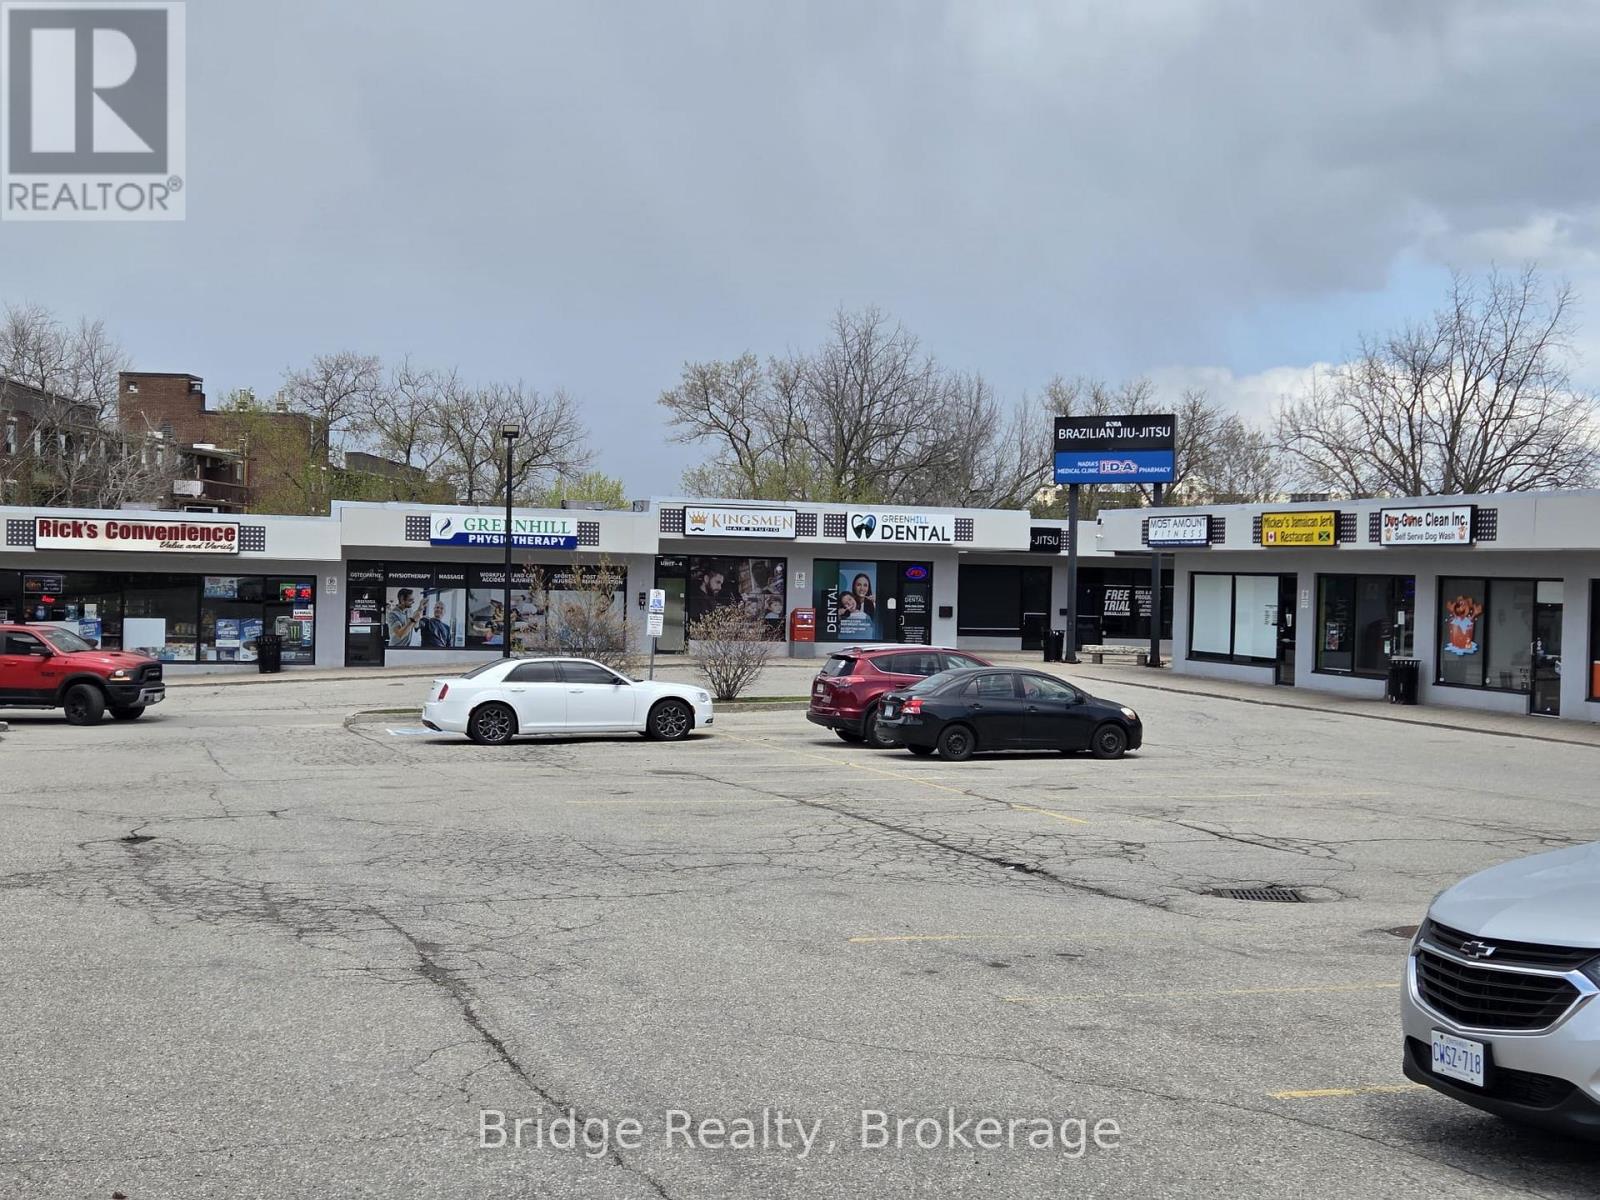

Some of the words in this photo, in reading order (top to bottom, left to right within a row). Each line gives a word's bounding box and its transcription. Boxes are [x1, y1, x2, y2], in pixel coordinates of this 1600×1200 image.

[1058, 427, 1115, 439] BRAZILIAN
[1117, 426, 1171, 438] JIU-JITSU
[712, 513, 793, 529] KINGSMEN
[881, 514, 929, 524] GREENHILL
[1150, 518, 1171, 528] MOST
[1173, 517, 1206, 528] AMOUNT
[1425, 512, 1450, 527] Clean
[1452, 511, 1468, 526] Inc.
[38, 519, 98, 539] Rick's
[105, 521, 236, 542] Convenience
[464, 517, 571, 534] GRENHILL
[881, 525, 951, 541] DENTAL
[1280, 530, 1314, 542] Restaurant
[1394, 532, 1406, 541] Self
[1407, 532, 1423, 540] Serve
[1425, 532, 1437, 542] Dog
[1439, 531, 1455, 540] Wash
[1031, 535, 1059, 545] -JITSU
[159, 541, 184, 549] Value
[204, 542, 235, 552] Variety
[1105, 589, 1131, 600] FREE
[826, 584, 839, 633] DENTAL
[1104, 600, 1130, 611] TRIAL
